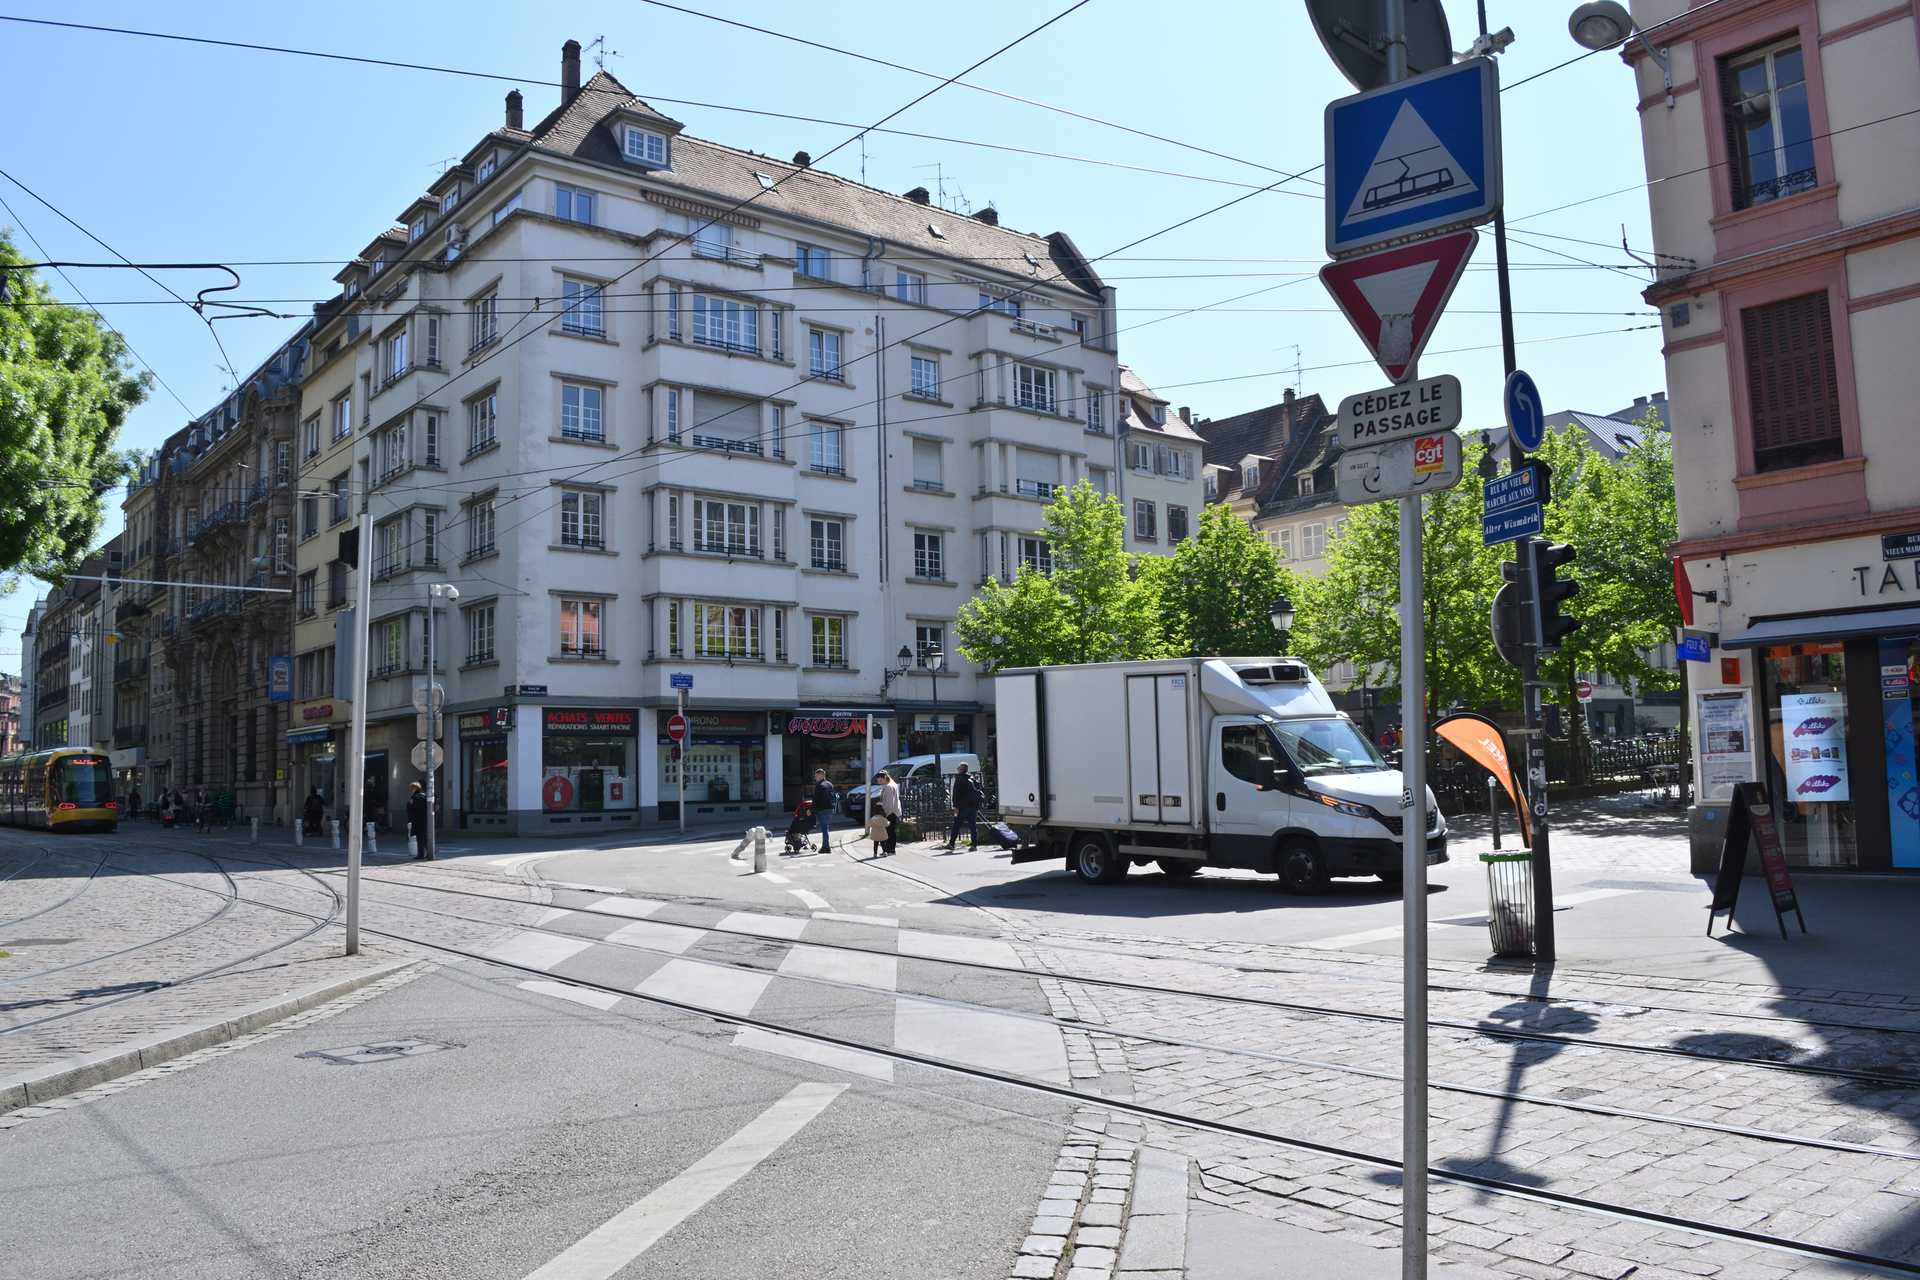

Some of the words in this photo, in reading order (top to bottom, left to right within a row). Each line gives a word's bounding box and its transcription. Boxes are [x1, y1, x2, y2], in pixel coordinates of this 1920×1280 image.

[1352, 390, 1411, 417] CÉDEZ
[1420, 384, 1442, 403] LE
[1353, 407, 1441, 439] PASSAGE
[1415, 443, 1443, 464] cgt
[1490, 485, 1500, 496] RUE
[1501, 481, 1508, 492] DU
[1508, 490, 1519, 502] AUX
[1519, 486, 1532, 497] VINS
[1484, 524, 1502, 535] Alter
[1886, 547, 1905, 555] VIEUX
[547, 712, 588, 722] ACHATS
[594, 712, 633, 723] VENTES
[590, 723, 610, 731] SMART
[610, 723, 632, 731] PHONE
